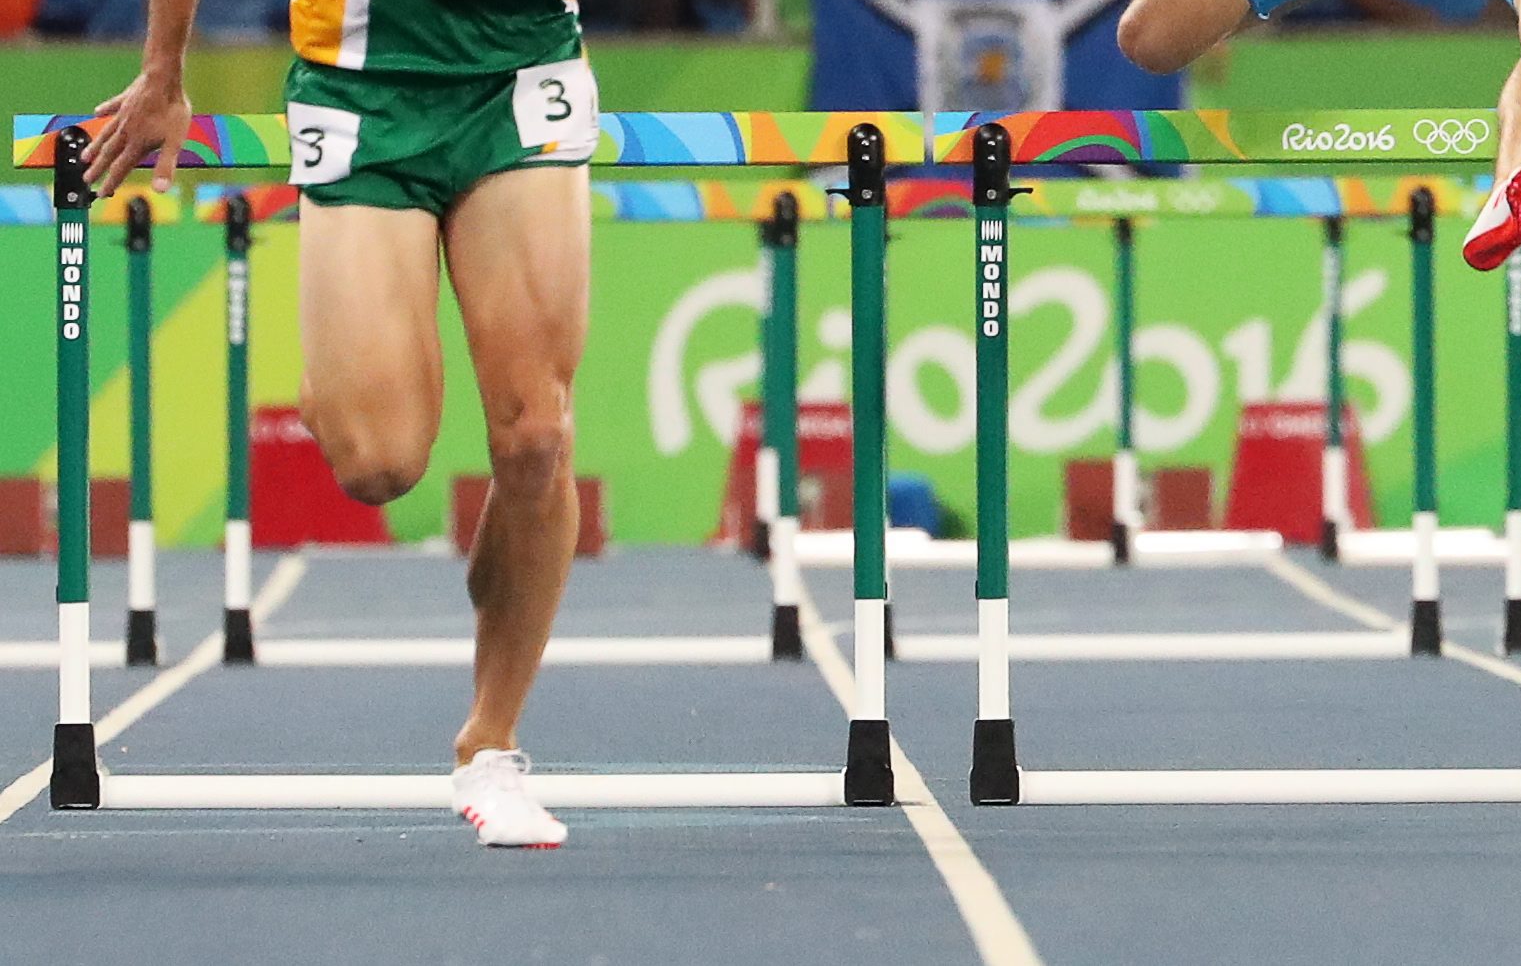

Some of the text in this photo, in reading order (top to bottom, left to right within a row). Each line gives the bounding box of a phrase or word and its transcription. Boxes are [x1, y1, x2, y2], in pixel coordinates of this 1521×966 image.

[538, 78, 572, 122] 3
[299, 127, 325, 168] 3
[1282, 123, 1395, 151] Rio2016
[61, 247, 84, 340] MONDO
[980, 245, 1003, 337] MONDO
